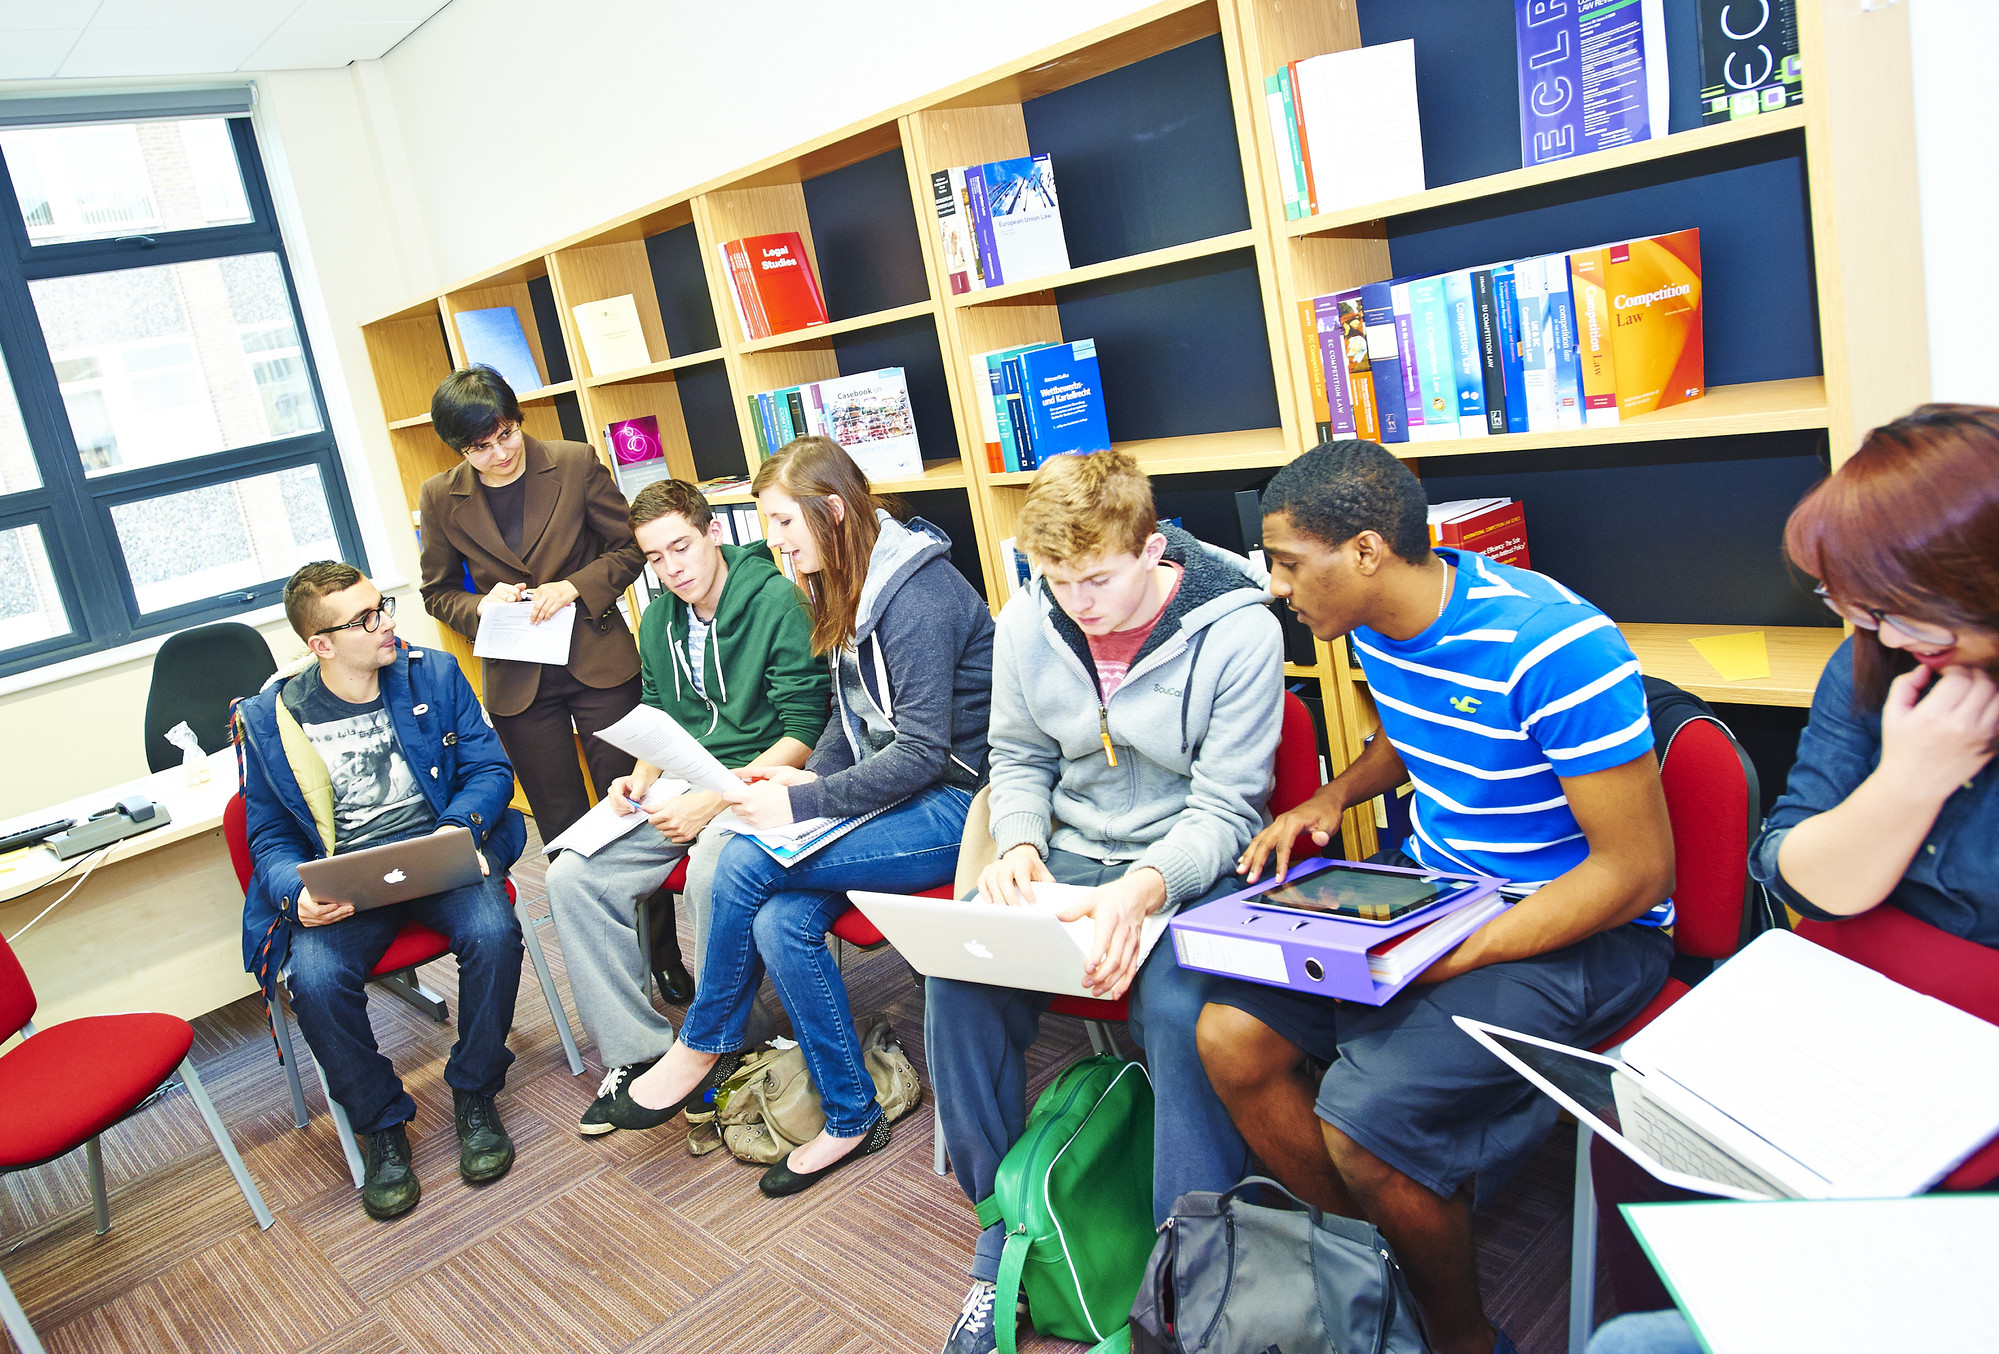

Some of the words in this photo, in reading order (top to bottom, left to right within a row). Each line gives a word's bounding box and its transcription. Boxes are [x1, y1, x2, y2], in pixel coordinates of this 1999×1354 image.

[998, 218, 1024, 228] European
[1024, 214, 1040, 223] Union
[1040, 212, 1052, 220] Law
[762, 246, 788, 258] Legal
[761, 258, 798, 270] Studies
[1614, 282, 1690, 310] Competition
[1424, 311, 1433, 324] EU
[1531, 320, 1538, 331] UK
[1616, 312, 1645, 328] Law
[1456, 302, 1469, 356] Competition
[1482, 313, 1493, 354] COMPETITION
[1522, 306, 1532, 348] Competition
[1559, 304, 1572, 349] competition
[1584, 286, 1600, 352] Competition
[1592, 354, 1602, 377] Law
[1308, 334, 1315, 343] EC
[1328, 338, 1334, 348] EC
[1426, 326, 1438, 375] Competition
[1564, 349, 1572, 362] law
[1309, 344, 1320, 383] Competition
[1462, 356, 1471, 374] Law
[1329, 350, 1342, 397] COMPETITION
[1040, 381, 1084, 398] Wettbewerbs-
[1432, 376, 1441, 392] Law
[837, 388, 872, 400] Casebook
[1042, 396, 1056, 406] und
[1056, 388, 1092, 403] Kartellrecht
[1336, 398, 1344, 414] LAW
[779, 407, 790, 444] CONTRAC
[1485, 522, 1504, 532] COMPETITION
